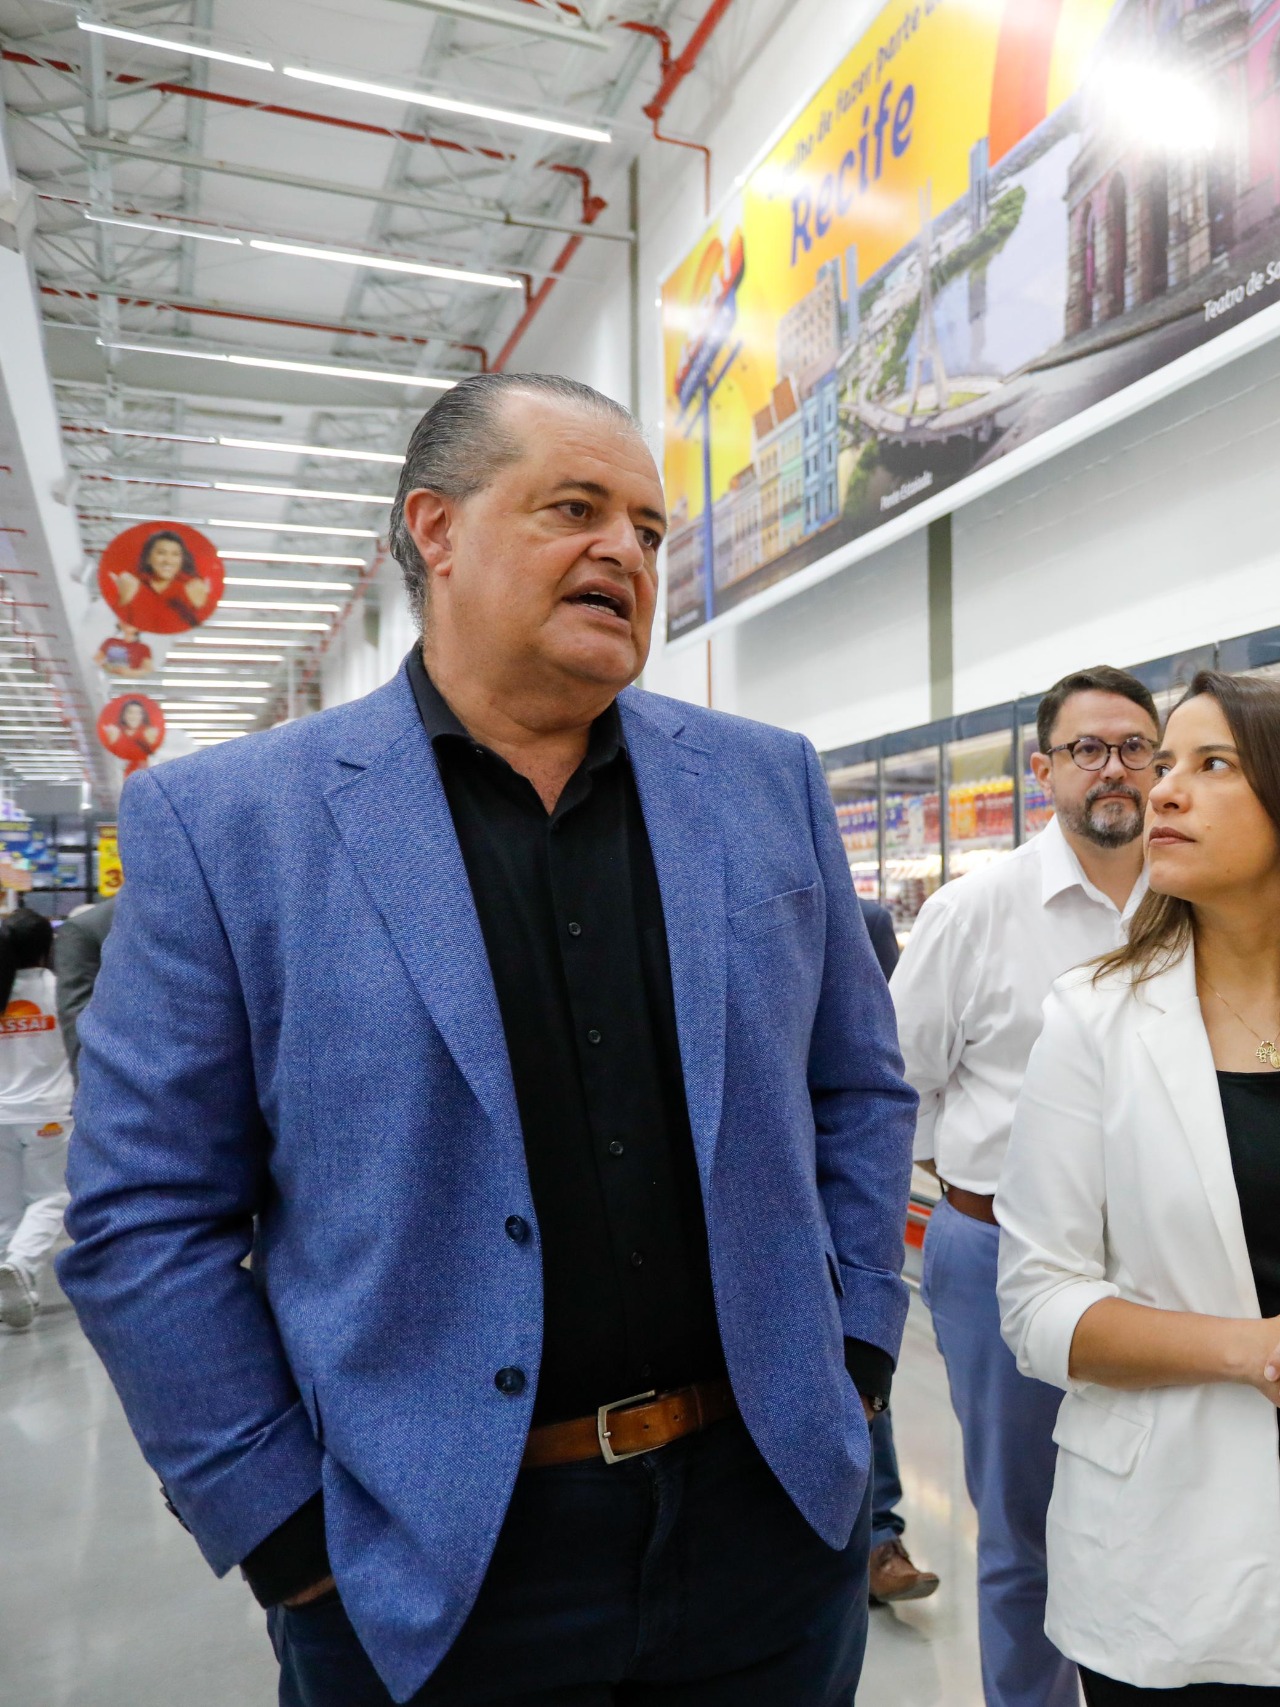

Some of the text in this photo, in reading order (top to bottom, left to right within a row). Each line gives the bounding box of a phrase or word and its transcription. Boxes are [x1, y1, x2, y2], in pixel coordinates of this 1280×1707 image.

[791, 79, 915, 268] Recife
[1203, 285, 1245, 322] Teatro
[1246, 271, 1265, 296] de
